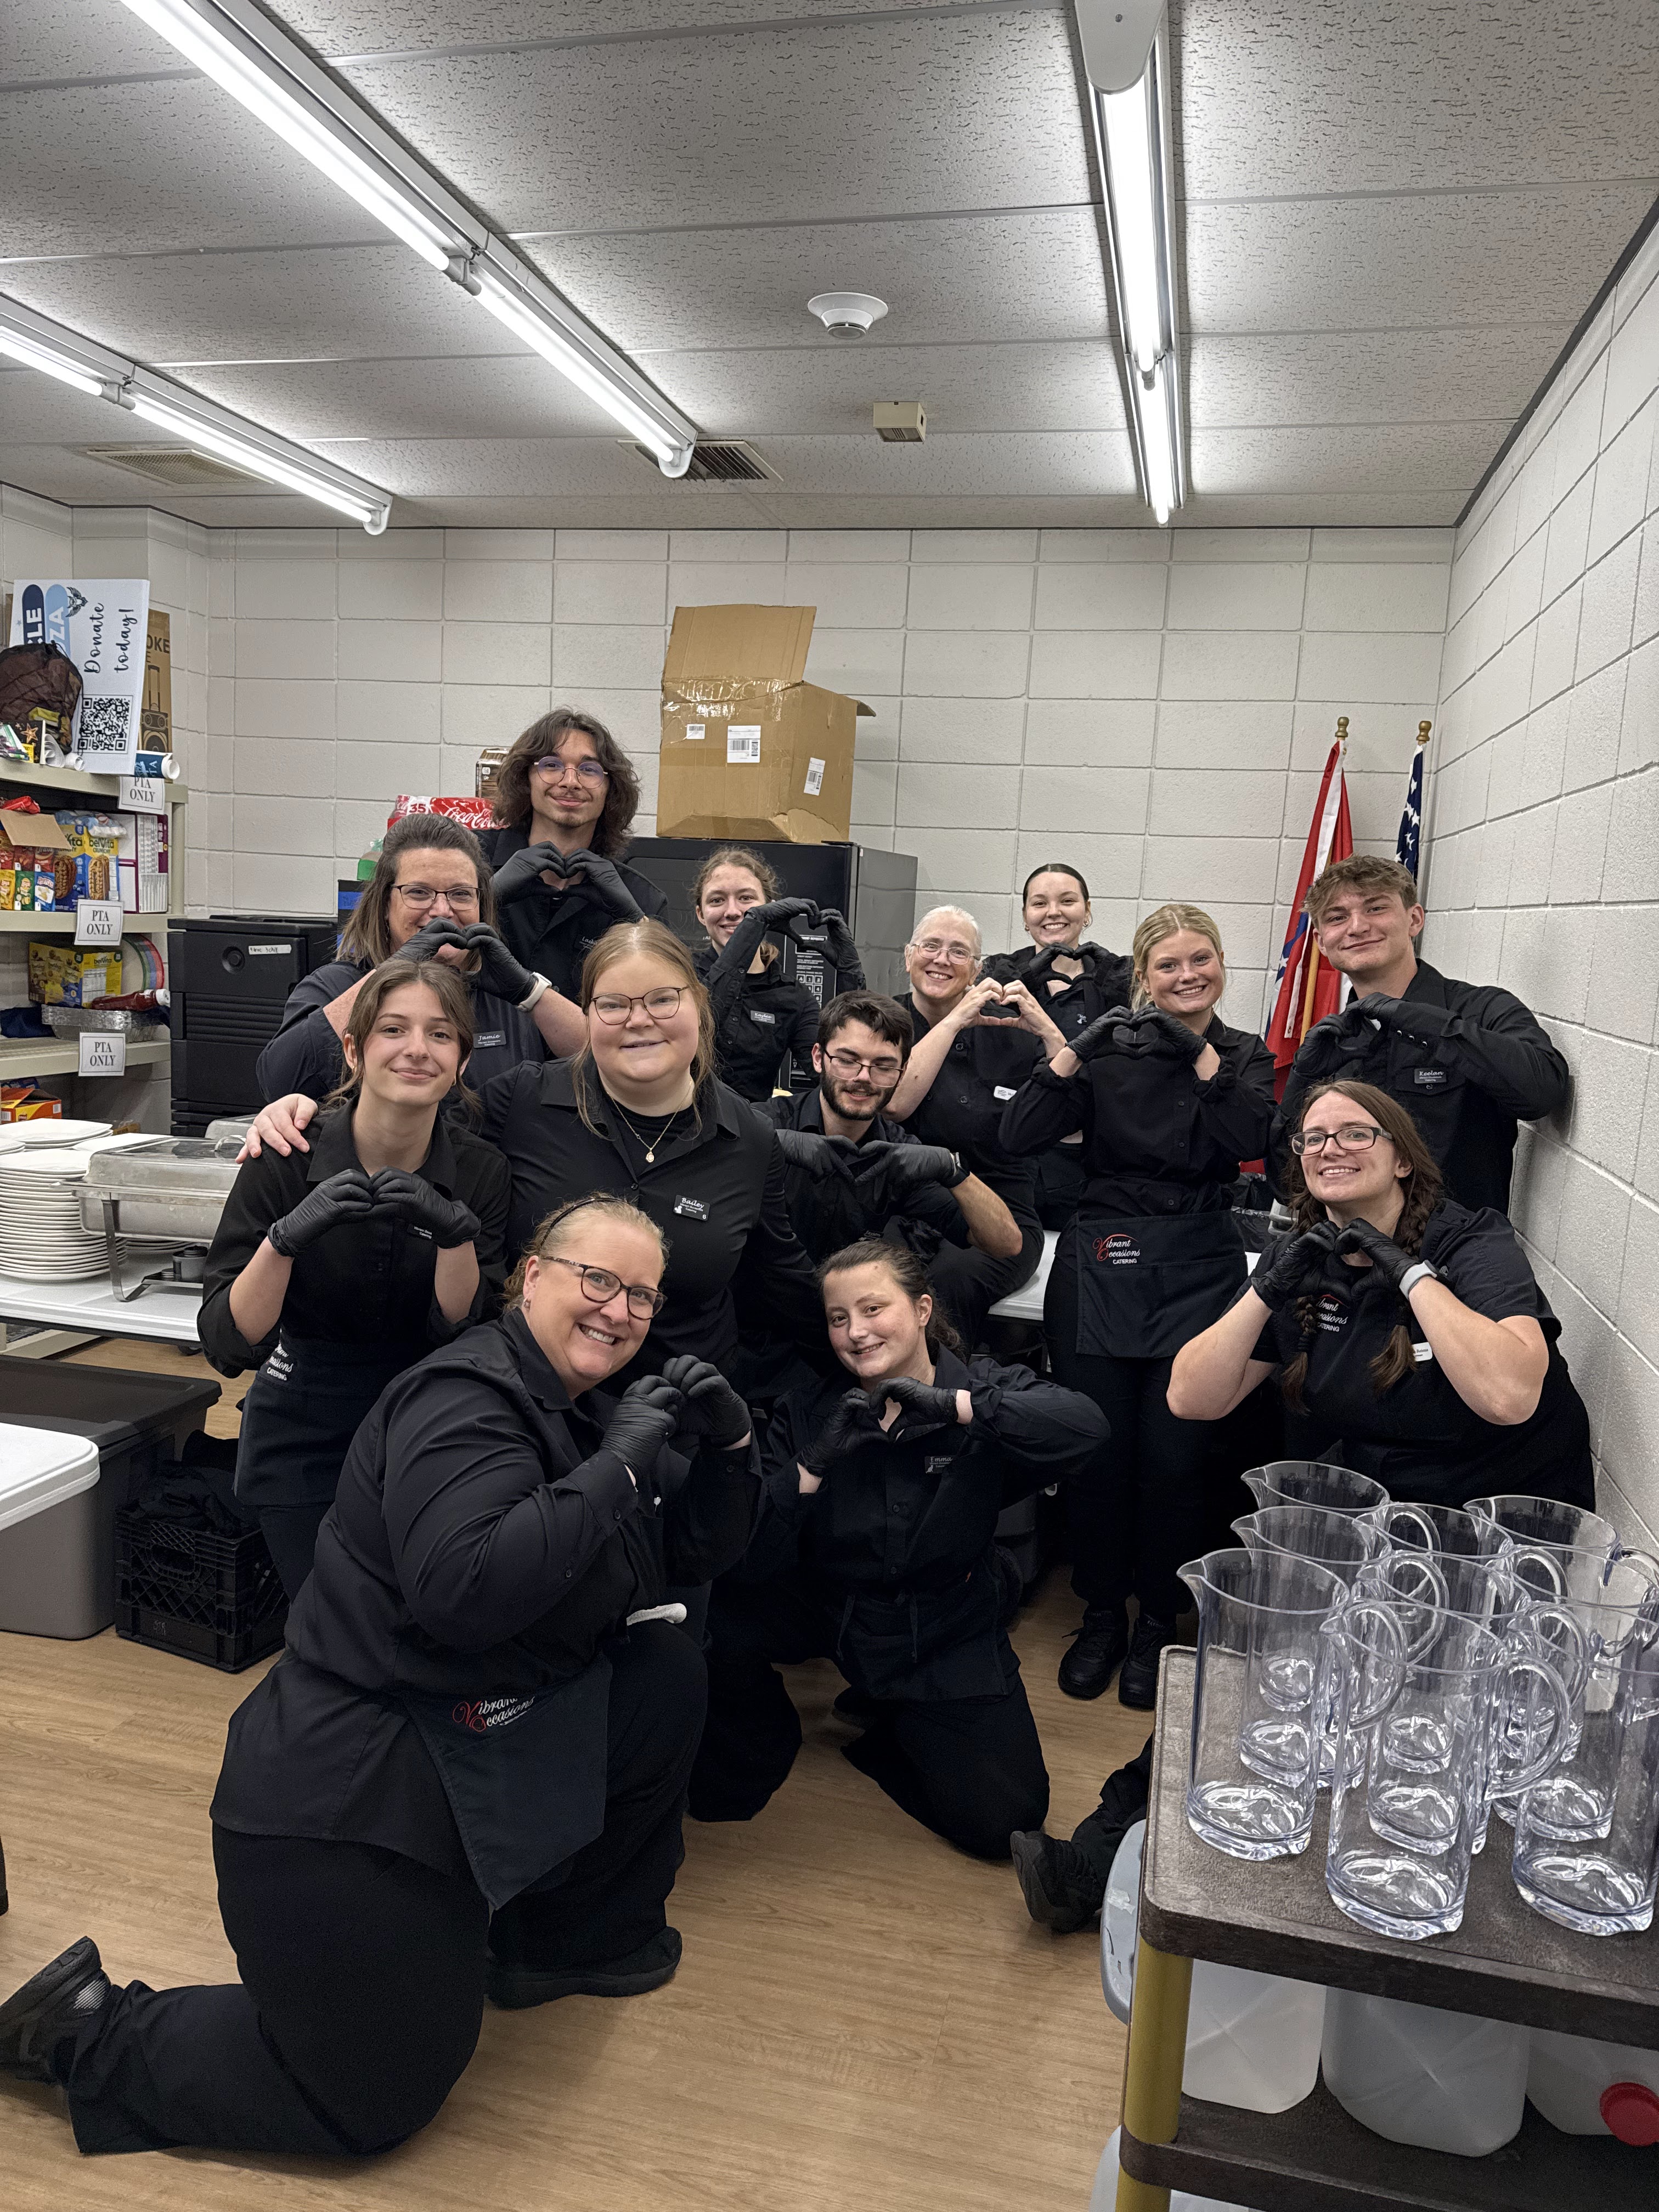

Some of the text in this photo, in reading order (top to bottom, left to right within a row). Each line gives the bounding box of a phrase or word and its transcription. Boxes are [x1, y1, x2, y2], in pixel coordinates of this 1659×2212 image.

[84, 603, 104, 673] Donate
[114, 609, 137, 673] today!
[134, 776, 151, 788] PTA
[130, 788, 155, 802] ONLY
[409, 803, 426, 814] 35
[92, 910, 110, 922] PTA
[87, 923, 113, 935] ONLY
[94, 1041, 112, 1053] PTA
[90, 1054, 116, 1066] ONLY
[681, 1197, 704, 1209] Bailey
[1092, 1235, 1131, 1251] Vibrant
[1097, 1248, 1141, 1262] Occasions
[267, 1367, 287, 1381] CATERING
[469, 1696, 535, 1733] Occasions
